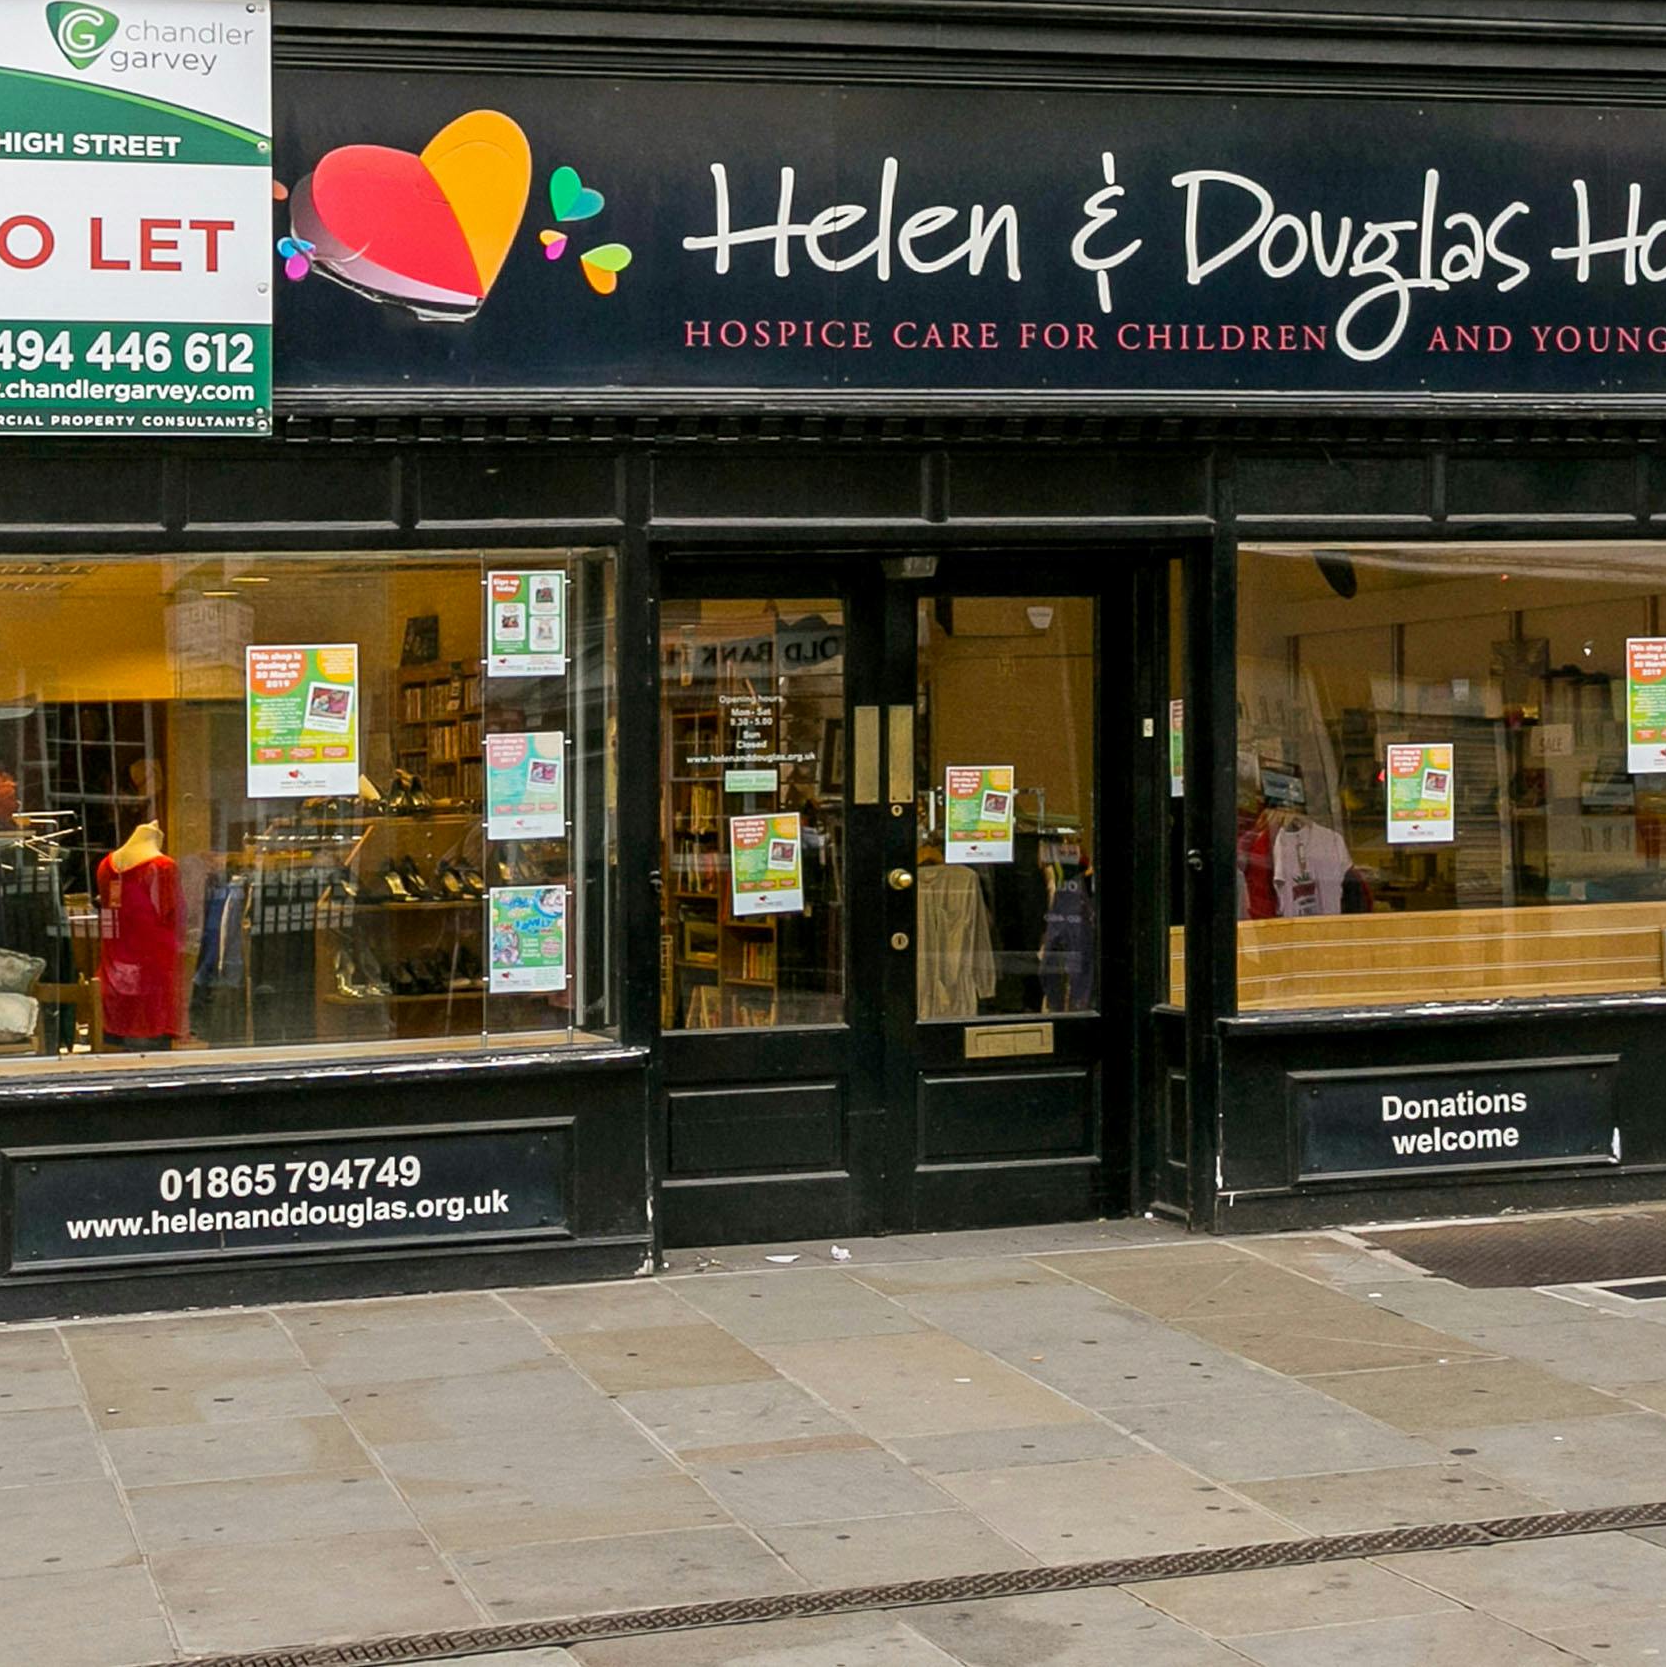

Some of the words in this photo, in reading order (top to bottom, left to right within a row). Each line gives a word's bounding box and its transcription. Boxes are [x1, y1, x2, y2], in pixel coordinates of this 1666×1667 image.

[125, 18, 254, 46] chandler
[109, 48, 218, 76] garvey
[72, 134, 182, 157] STREET
[89, 216, 236, 273] LET
[683, 156, 1021, 282] Helen
[1071, 151, 1143, 314] &
[1170, 167, 1530, 362] Douglas
[684, 320, 873, 349] HOSPICE
[893, 321, 1000, 350] CARE
[1020, 322, 1098, 350] FOR
[1117, 322, 1328, 352] CHILDREN
[1428, 324, 1513, 353] AND
[85, 331, 172, 373] 446
[183, 332, 255, 374] 612
[50, 414, 135, 427] PROPERTY
[141, 415, 255, 428] CONSULTANTS
[719, 695, 757, 705] Opening
[758, 694, 783, 703] hours
[686, 752, 816, 764] www.helenanddouglas.org.uk
[736, 740, 768, 750] Closed
[1381, 1089, 1528, 1122] Donations
[1391, 1124, 1520, 1155] welcome
[159, 1161, 278, 1202] 01865
[284, 1155, 422, 1195] 794749
[66, 1189, 510, 1240] www.helenanddouglas.org.uk
